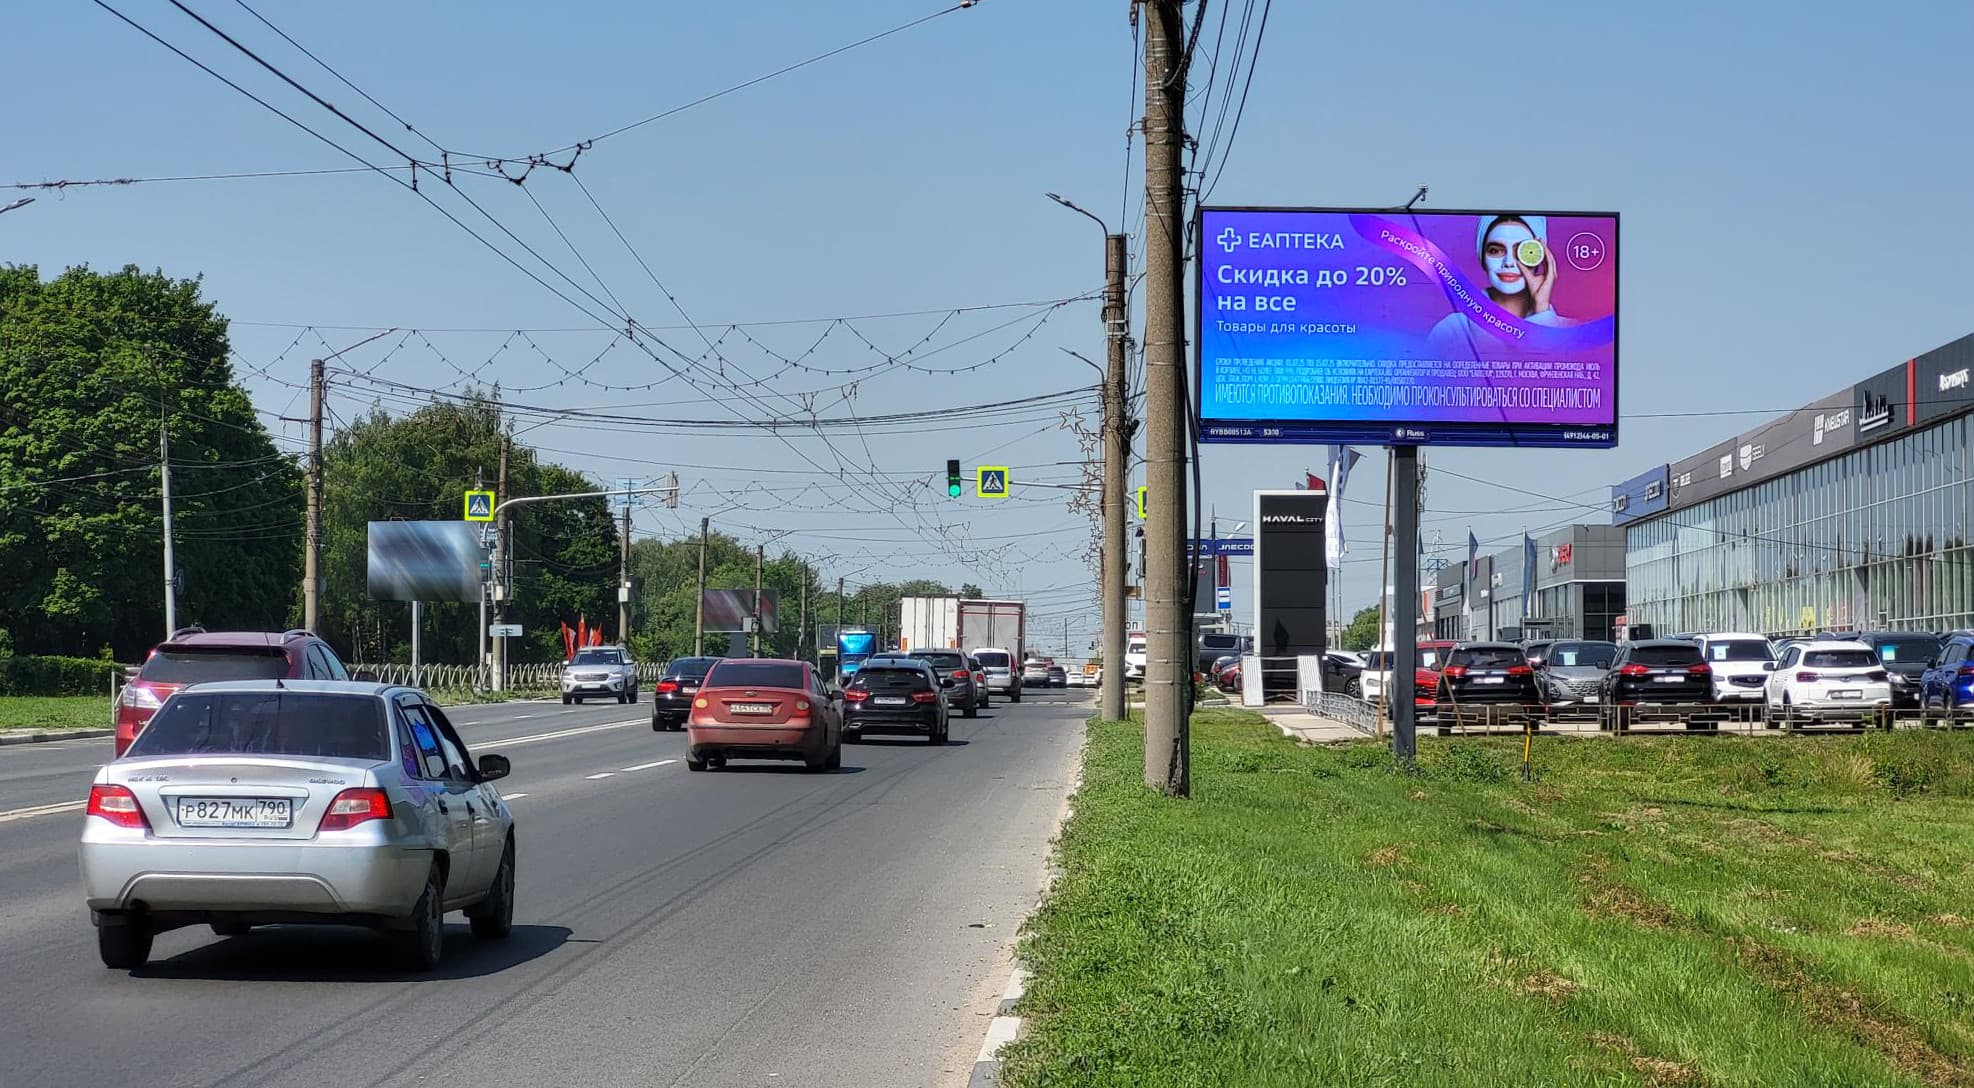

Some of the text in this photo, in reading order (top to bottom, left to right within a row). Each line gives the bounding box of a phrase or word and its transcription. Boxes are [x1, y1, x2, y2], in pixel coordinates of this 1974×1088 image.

[1249, 233, 1343, 249] ЕАПТЕКА
[1574, 245, 1599, 259] 18+
[1217, 264, 1407, 287] Скидка до 20%
[1380, 230, 1525, 339] Раскройте природную красоту
[1217, 295, 1296, 311] на все
[1217, 320, 1356, 334] Товары для красоты
[1216, 384, 1600, 411] ИМЕЮТСЯ ПРОТИВОПОКАЗАНИЯ. НЕОБХОДИМО ПРОКОНСУЛЬТИРОВАТЬСЯ СО СПЕЦИАЛИСТОМ
[1406, 429, 1424, 437] Russ
[185, 802, 254, 820] Р827МК
[259, 801, 285, 815] 790
